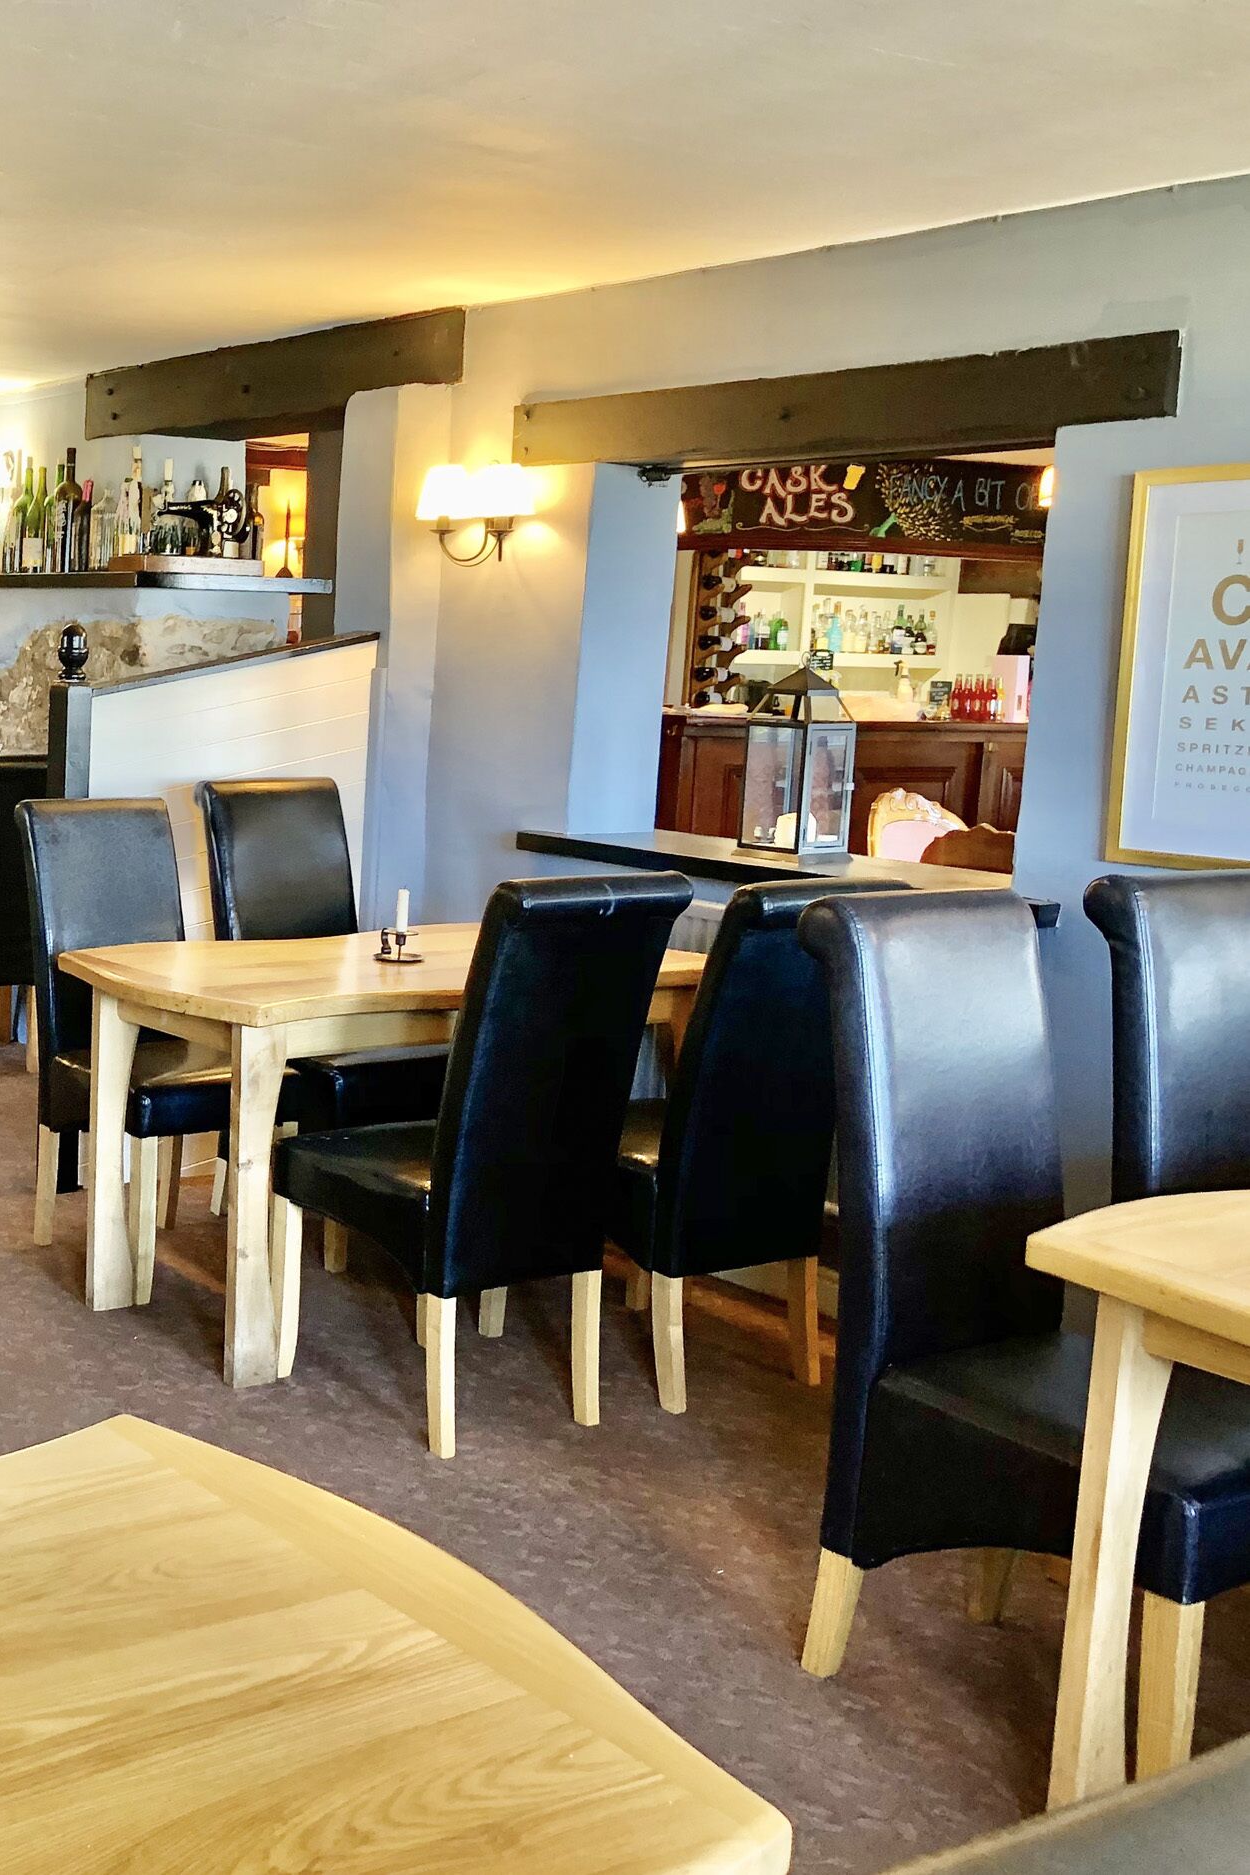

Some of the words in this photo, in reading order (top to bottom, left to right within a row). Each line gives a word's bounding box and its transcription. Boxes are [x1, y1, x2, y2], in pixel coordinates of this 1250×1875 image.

[739, 465, 838, 498] CASK
[890, 473, 949, 510] FANCY
[950, 479, 966, 512] A
[975, 478, 1006, 511] BIT
[759, 492, 854, 526] ALES
[1212, 575, 1250, 626] C
[1182, 638, 1250, 670] AV
[1179, 716, 1246, 732] SEK
